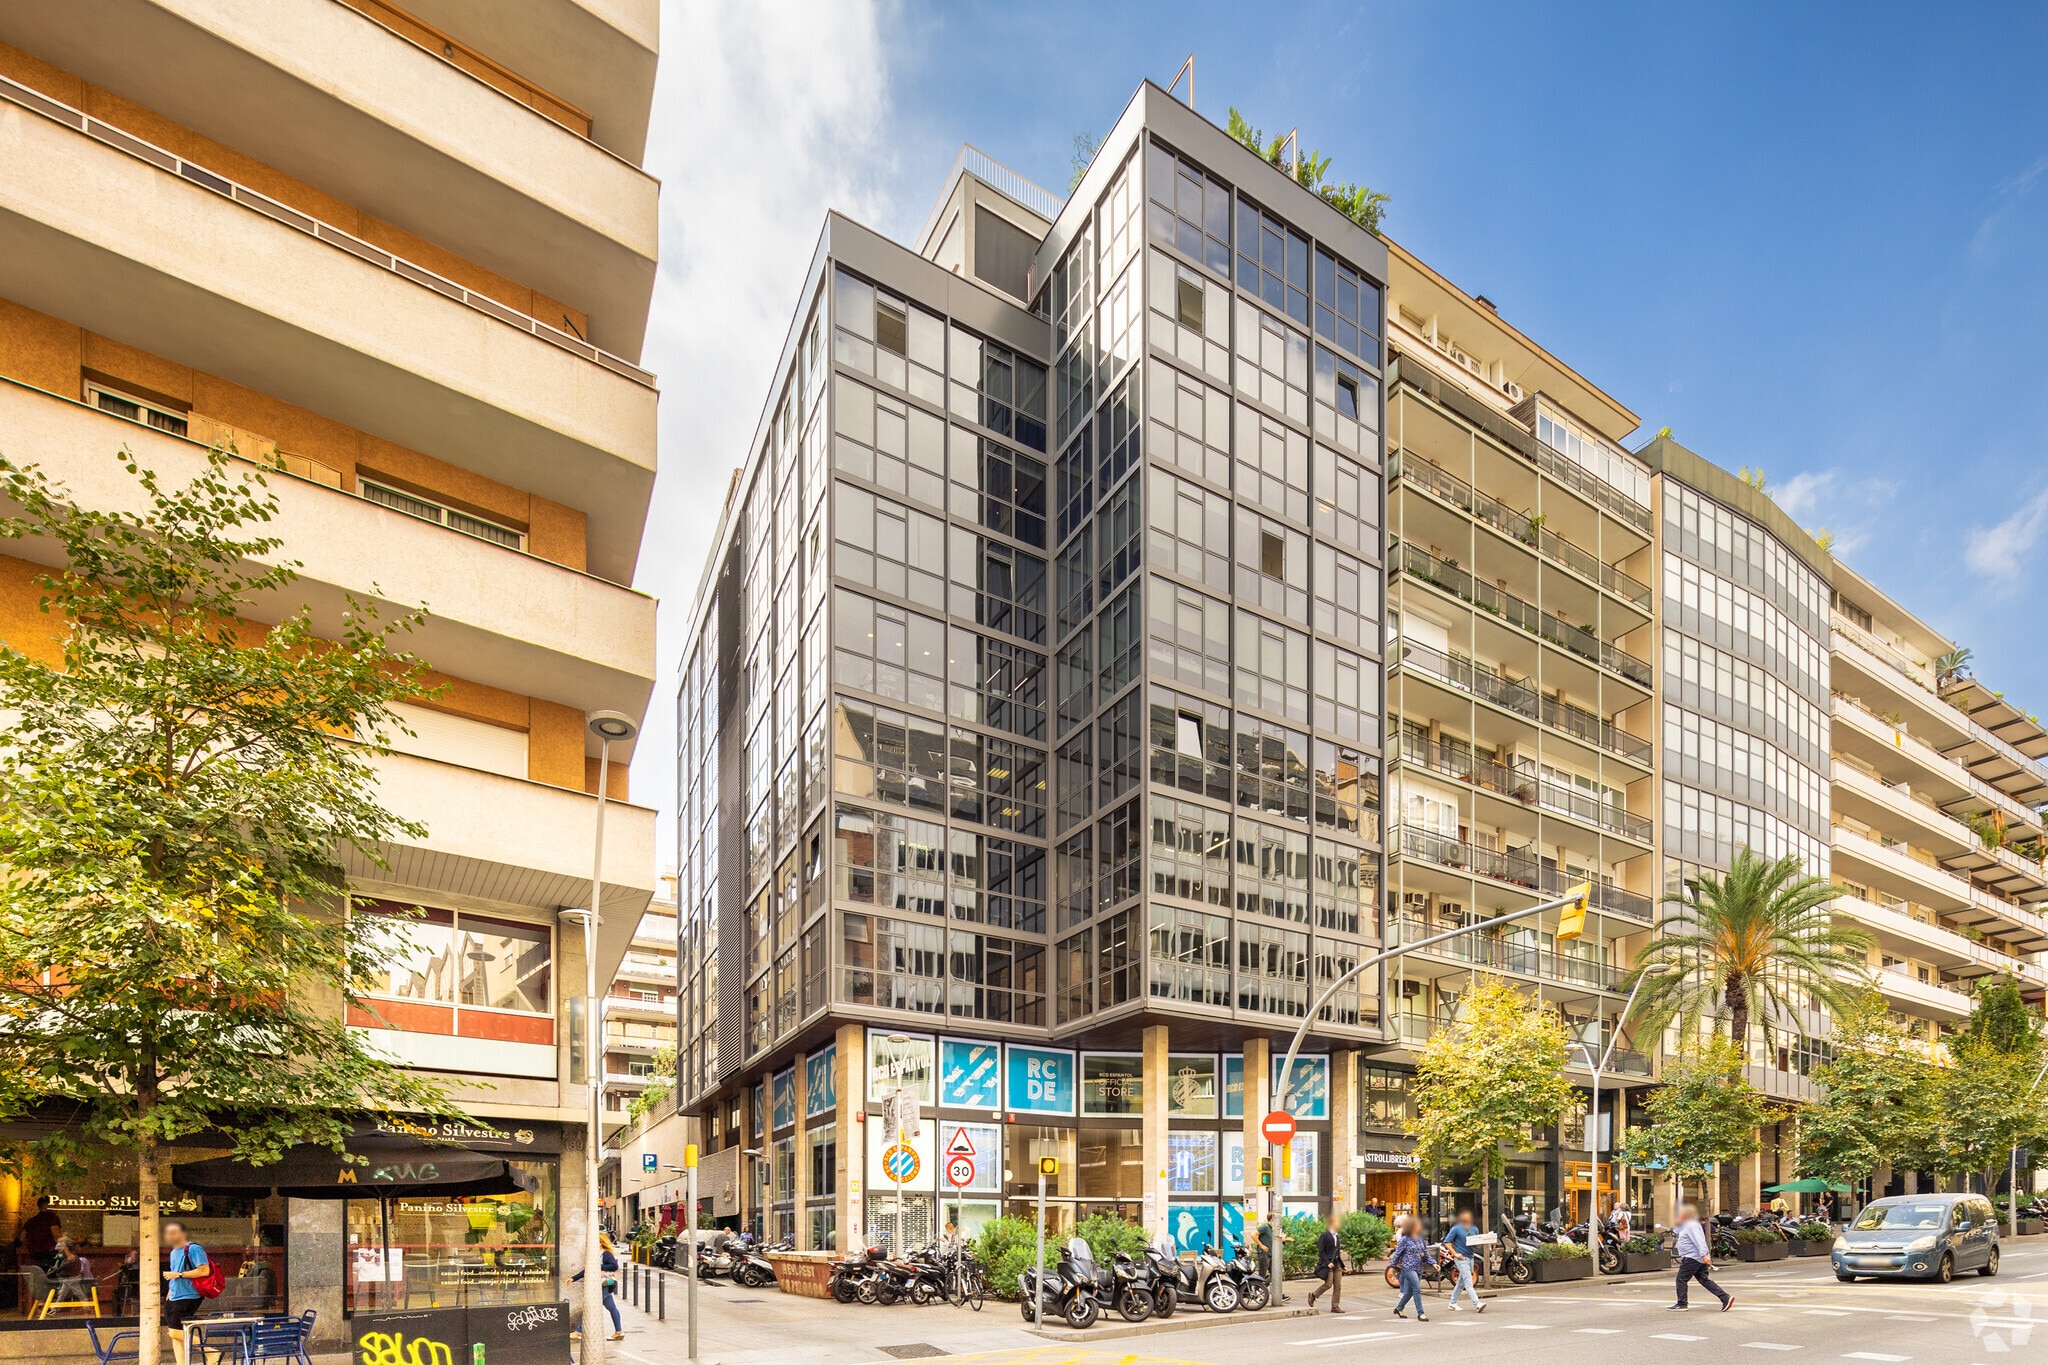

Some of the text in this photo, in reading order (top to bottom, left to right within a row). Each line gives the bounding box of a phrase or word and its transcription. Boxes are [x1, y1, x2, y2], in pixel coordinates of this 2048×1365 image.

[890, 1054, 931, 1077] EPANYOL
[1027, 1057, 1056, 1079] RC
[1027, 1079, 1056, 1101] DE
[1098, 1087, 1134, 1096] STORE
[442, 1123, 511, 1139] Silvestre
[644, 1155, 655, 1166] P
[893, 1145, 919, 1162] EPANYOL
[1231, 1145, 1244, 1163] R
[953, 1166, 969, 1177] 30
[1231, 1165, 1244, 1181] D
[48, 1195, 174, 1208] Panino Silvre
[400, 1202, 494, 1213] Panino Silvestre
